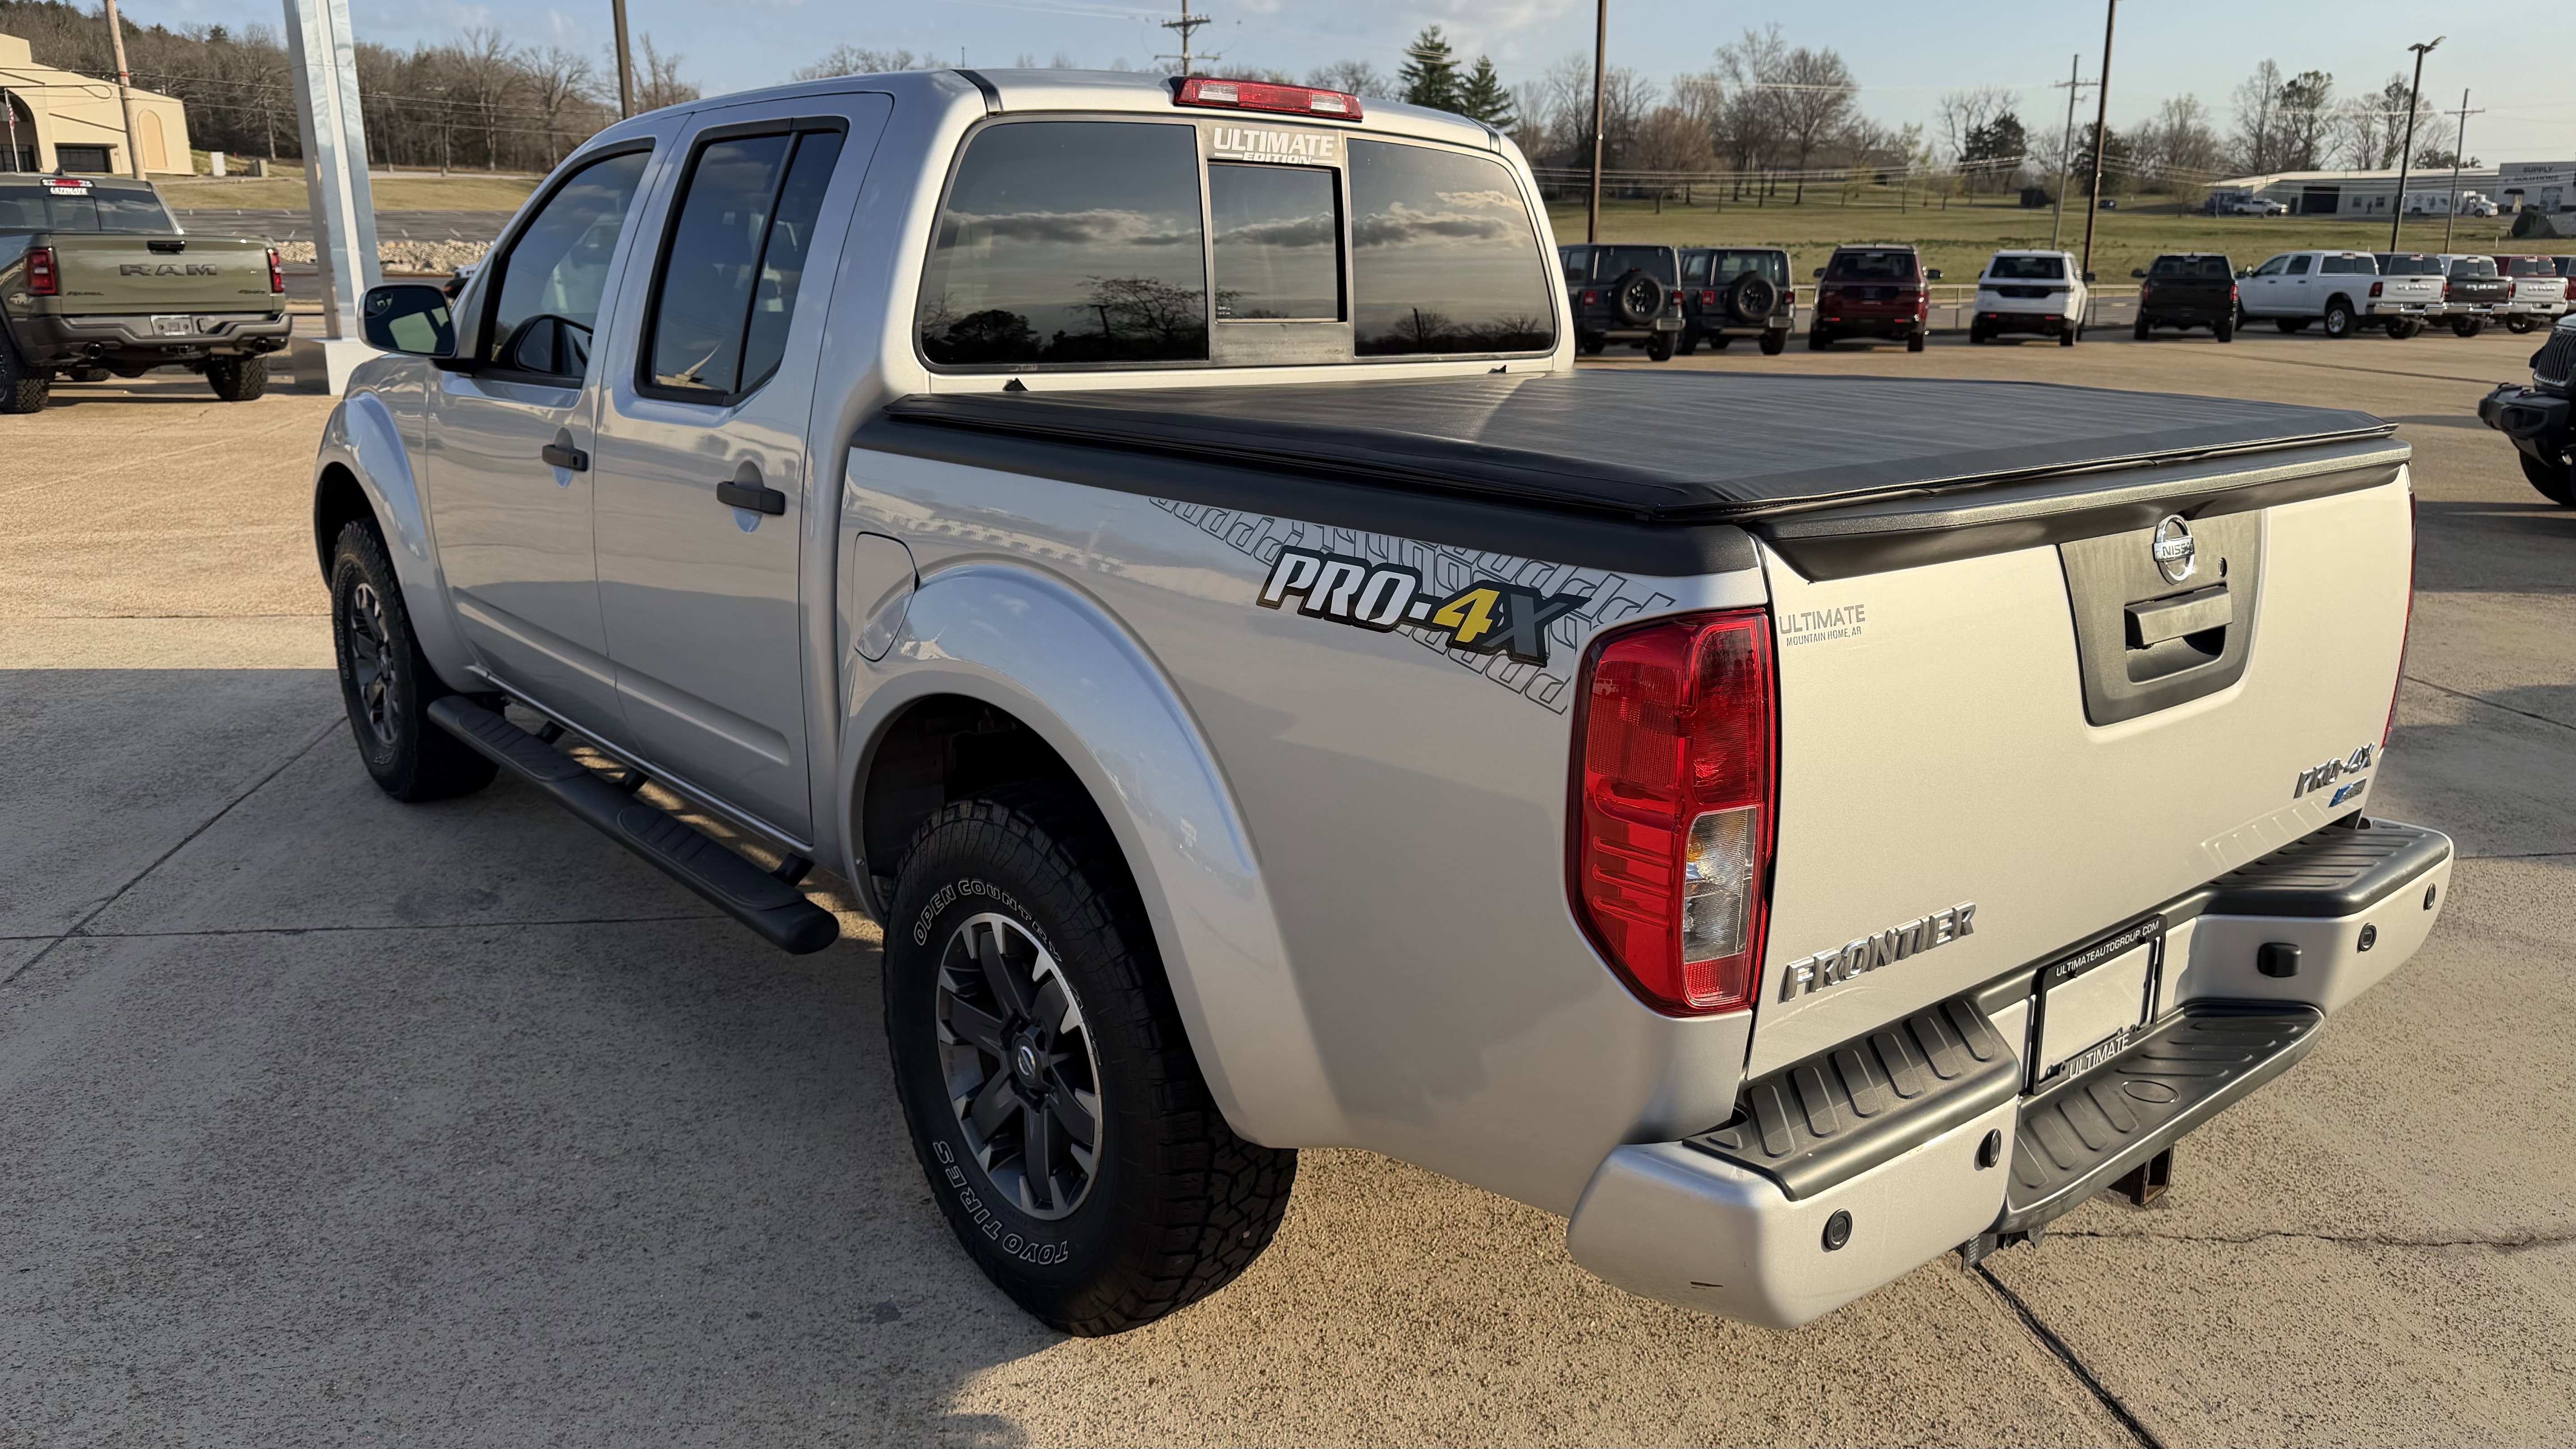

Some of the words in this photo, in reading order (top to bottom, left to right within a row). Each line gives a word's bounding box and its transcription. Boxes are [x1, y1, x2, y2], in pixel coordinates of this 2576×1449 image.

[1214, 128, 1334, 156] ULTIMATE
[1243, 152, 1311, 165] EDITION
[119, 264, 217, 276] RAM
[1263, 550, 1574, 659] PRO-4X
[1779, 604, 1866, 635] ULTIMATE
[1786, 632, 1826, 647] MOUNTAIN
[1827, 628, 1850, 640] HOME,
[1852, 626, 1862, 636] AR
[914, 884, 957, 946] OPEN
[958, 880, 1062, 962] COUNTRY
[1778, 900, 1976, 1004] FRONTIER
[2056, 920, 2159, 977] ULTIMATEAUTOGROUP.COM
[2069, 1033, 2130, 1078] ULTIMATE
[933, 1141, 1003, 1241] TIRES
[1002, 1233, 1068, 1265] TOYO
